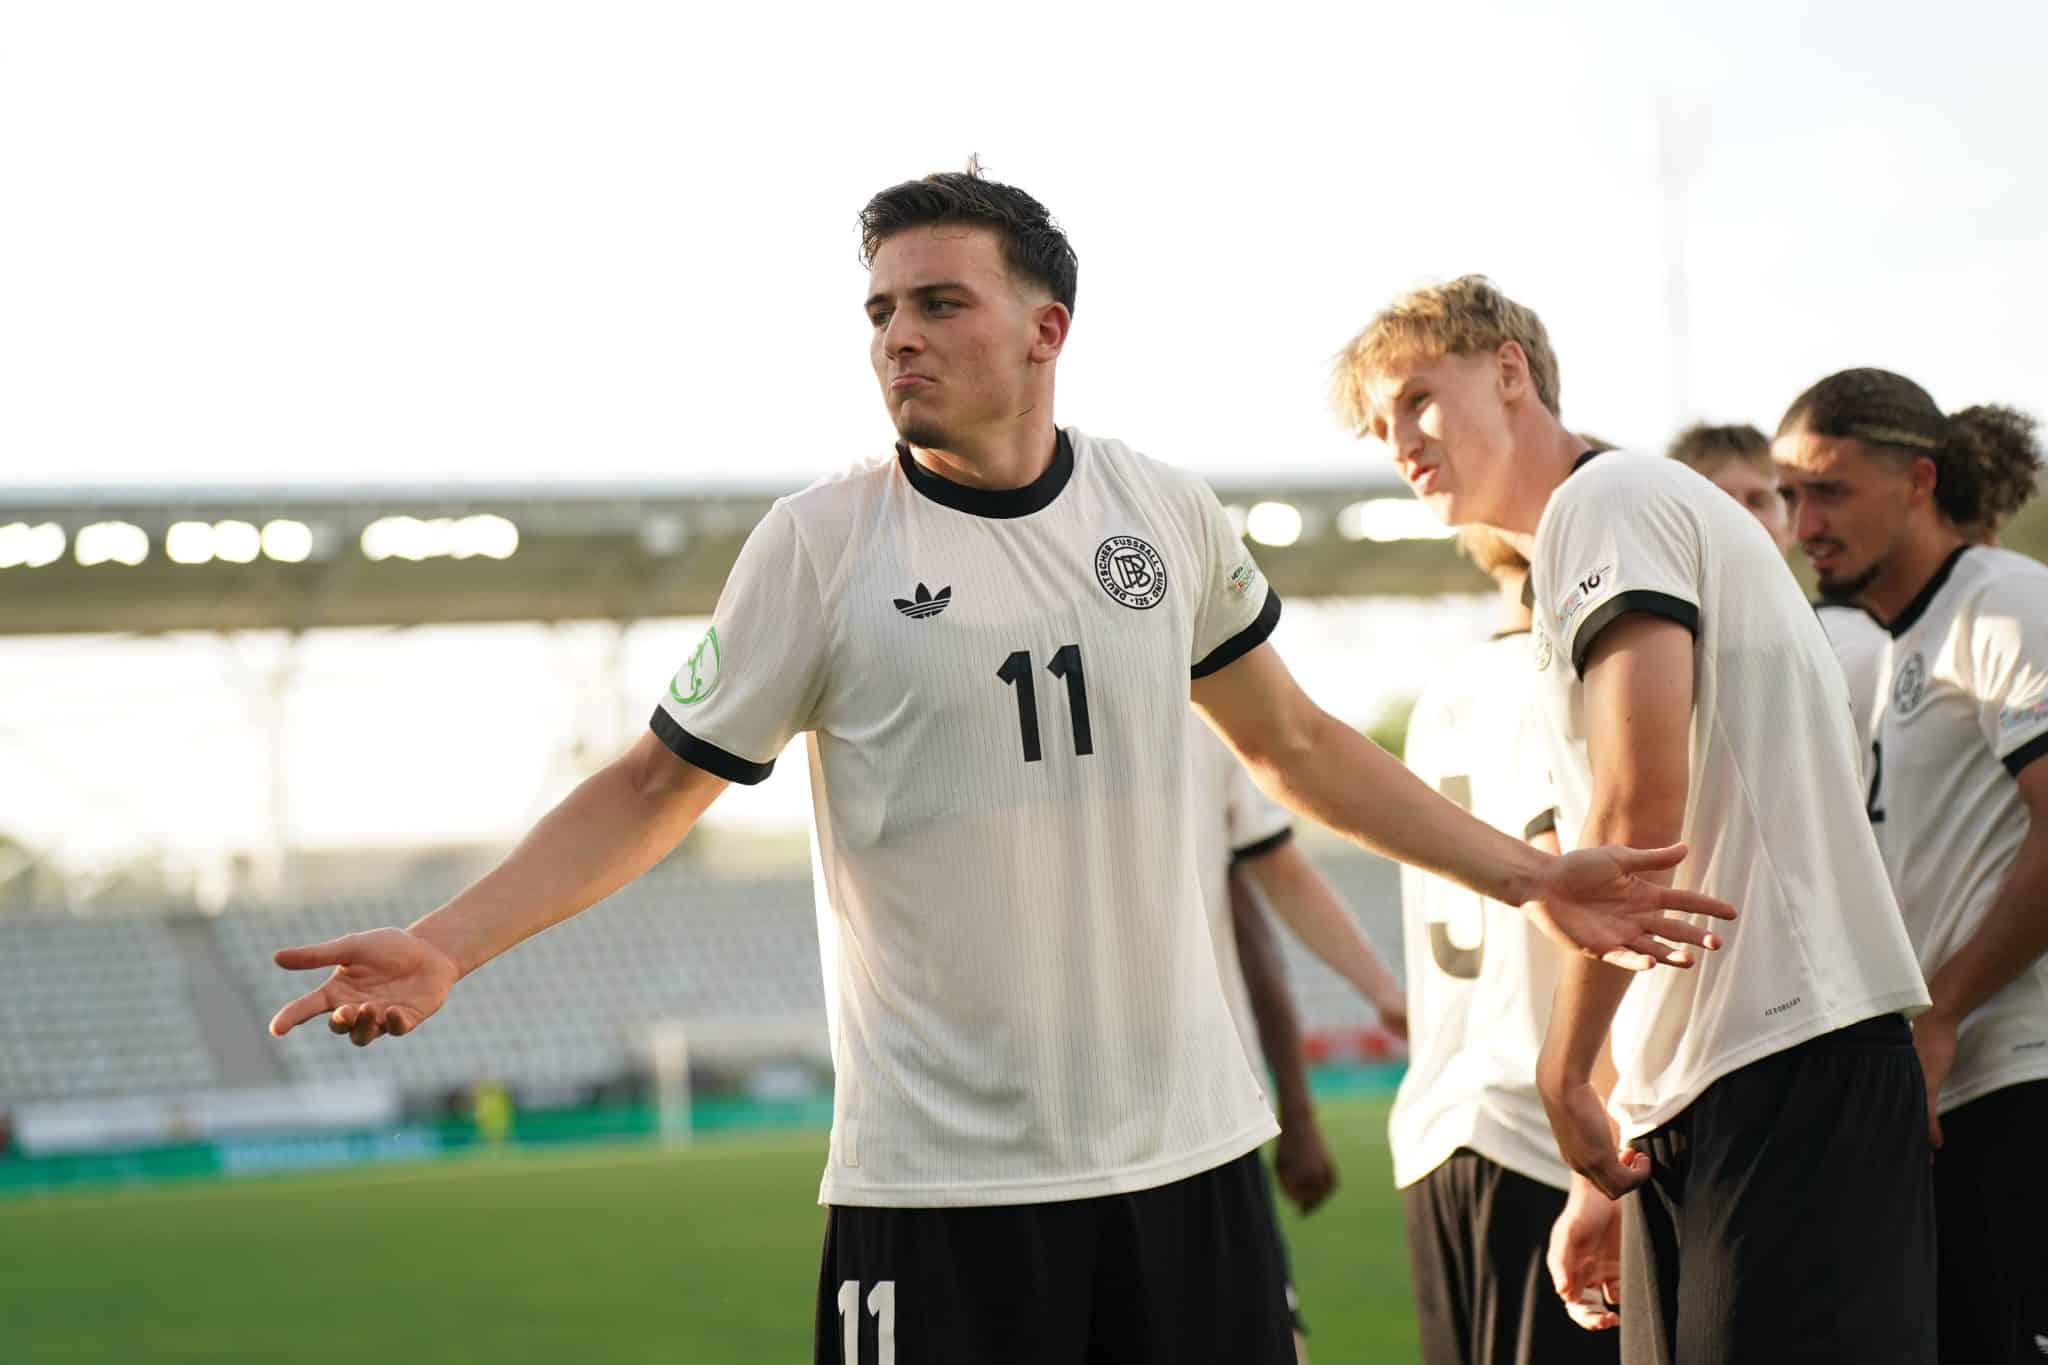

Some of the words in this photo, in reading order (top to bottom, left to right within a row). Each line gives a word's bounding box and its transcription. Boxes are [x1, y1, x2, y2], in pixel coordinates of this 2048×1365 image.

[1098, 545, 1127, 600] DEUTSCHER
[996, 644, 1094, 762] 11
[837, 1279, 896, 1365] 11
